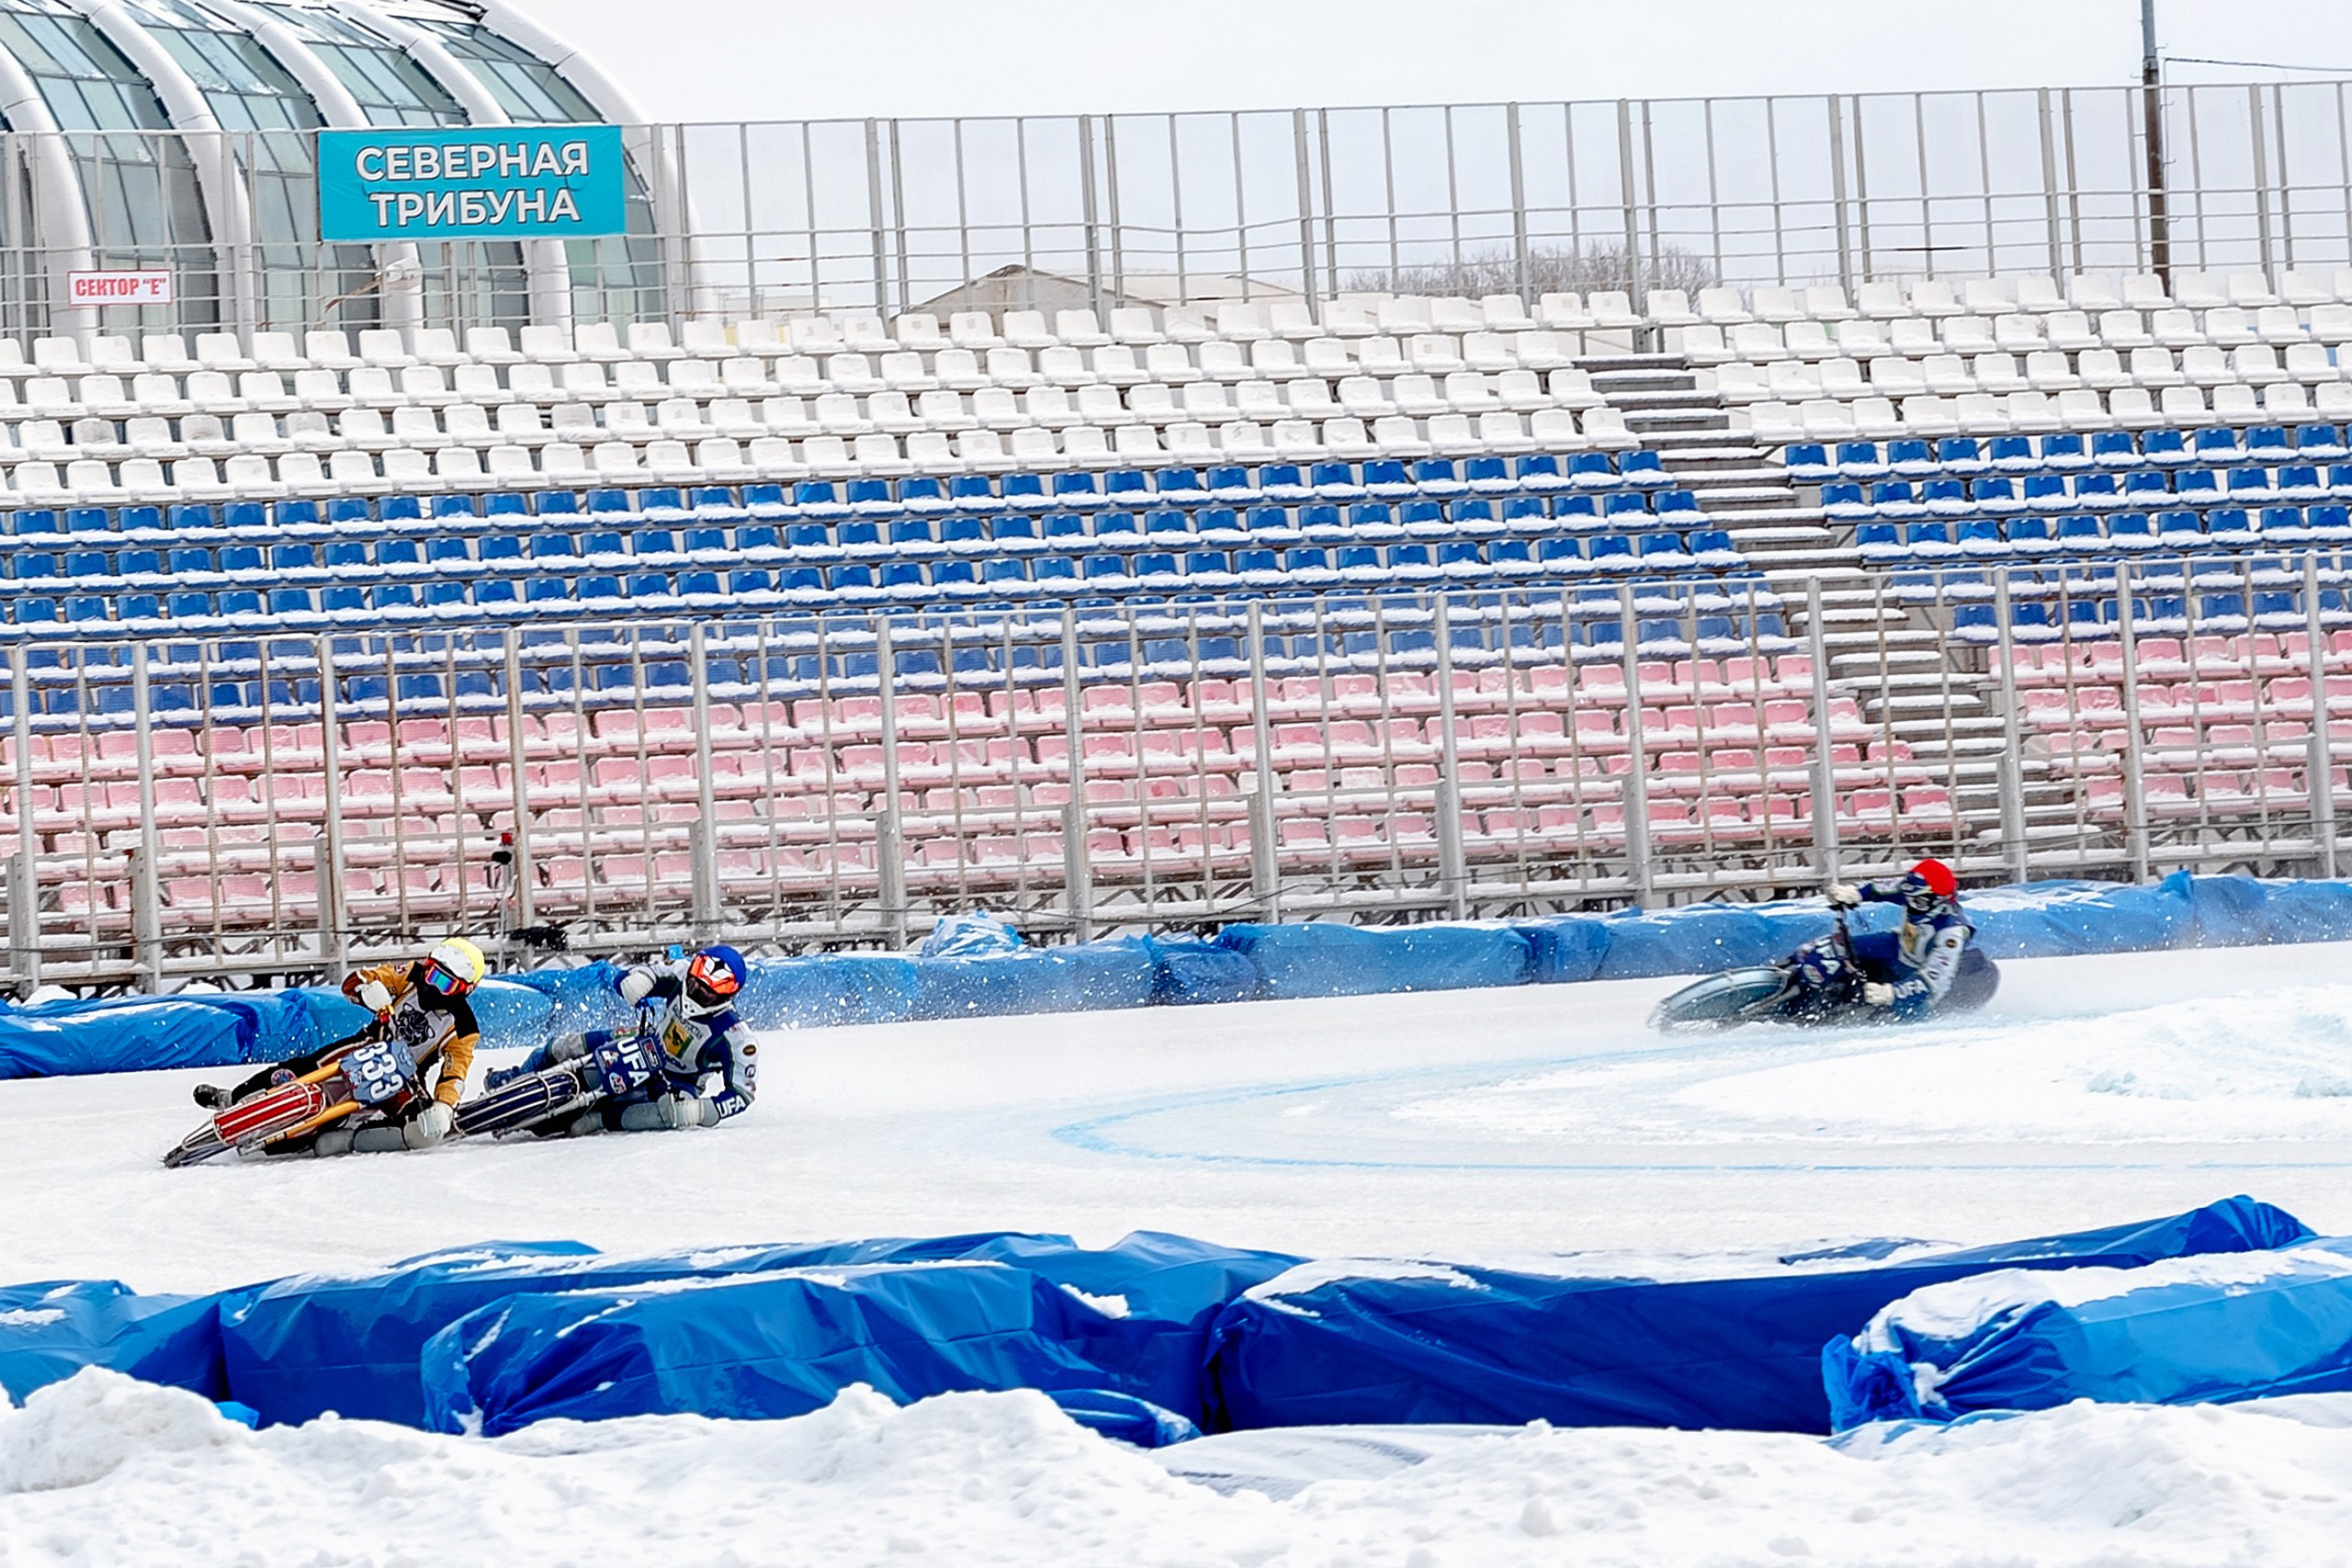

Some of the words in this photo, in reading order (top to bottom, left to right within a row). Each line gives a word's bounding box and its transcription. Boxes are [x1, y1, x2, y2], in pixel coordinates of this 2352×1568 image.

[355, 141, 589, 181] СЕВЕРНАЯ
[368, 187, 582, 227] ТРИБУНА
[75, 278, 139, 296] СЕКТОР
[353, 1042, 404, 1100] 333
[617, 1036, 650, 1088] UFA
[716, 1094, 746, 1118] UFA
